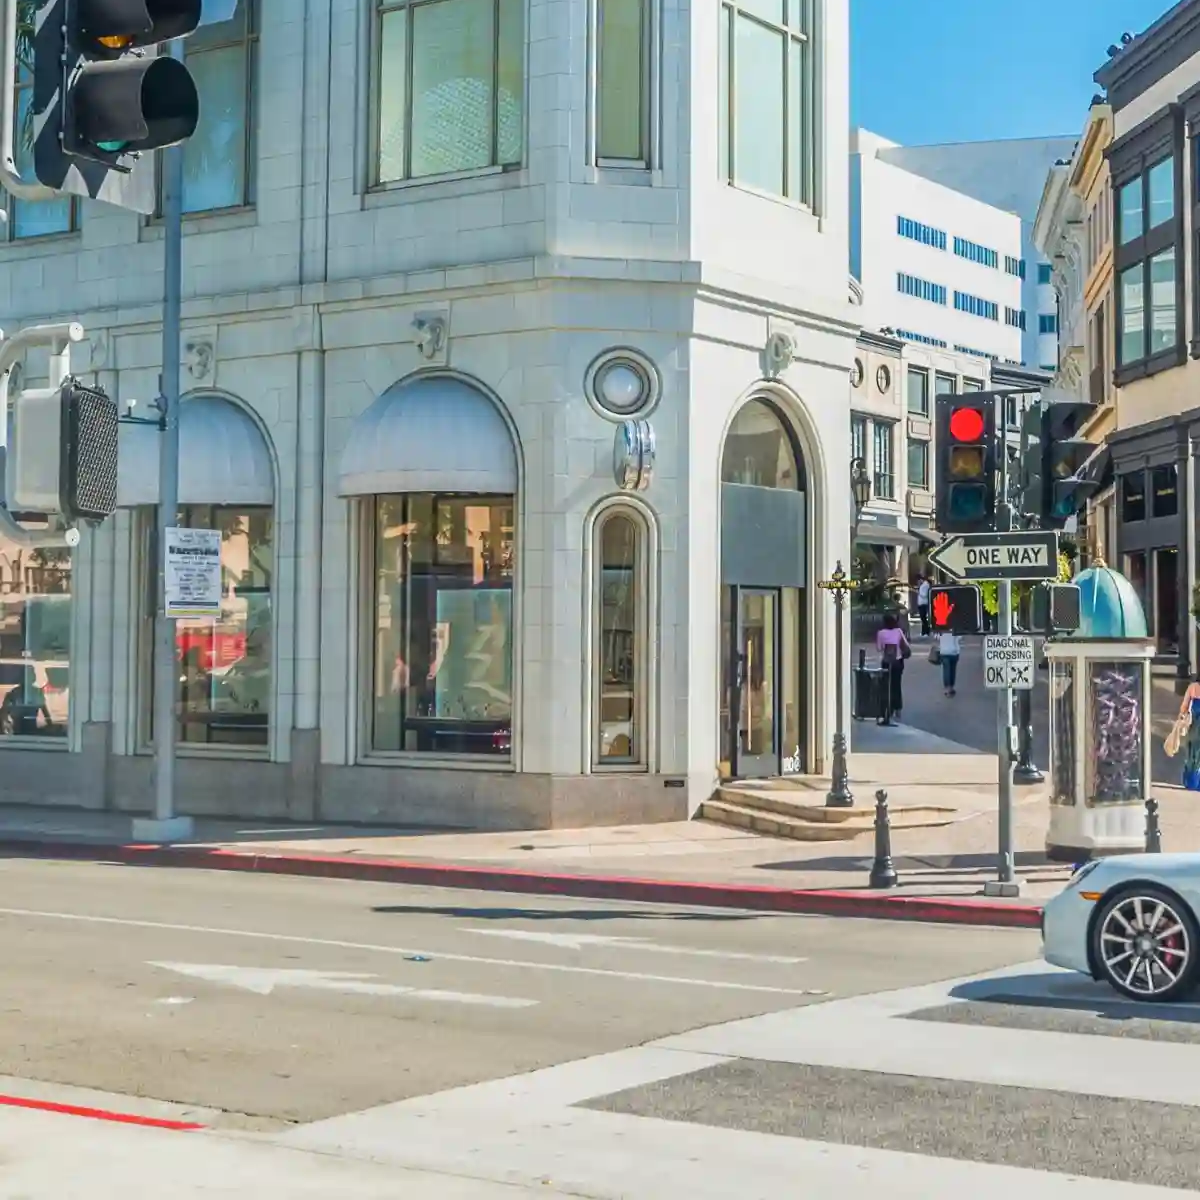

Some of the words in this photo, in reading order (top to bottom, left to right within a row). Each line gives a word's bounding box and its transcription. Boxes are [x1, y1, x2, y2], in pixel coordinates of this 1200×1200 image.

[967, 548, 1000, 565] ONE
[1007, 547, 1042, 564] WAY
[987, 638, 1031, 648] DIAGONAL
[986, 650, 1032, 660] CROSSING
[987, 666, 1005, 683] OK
